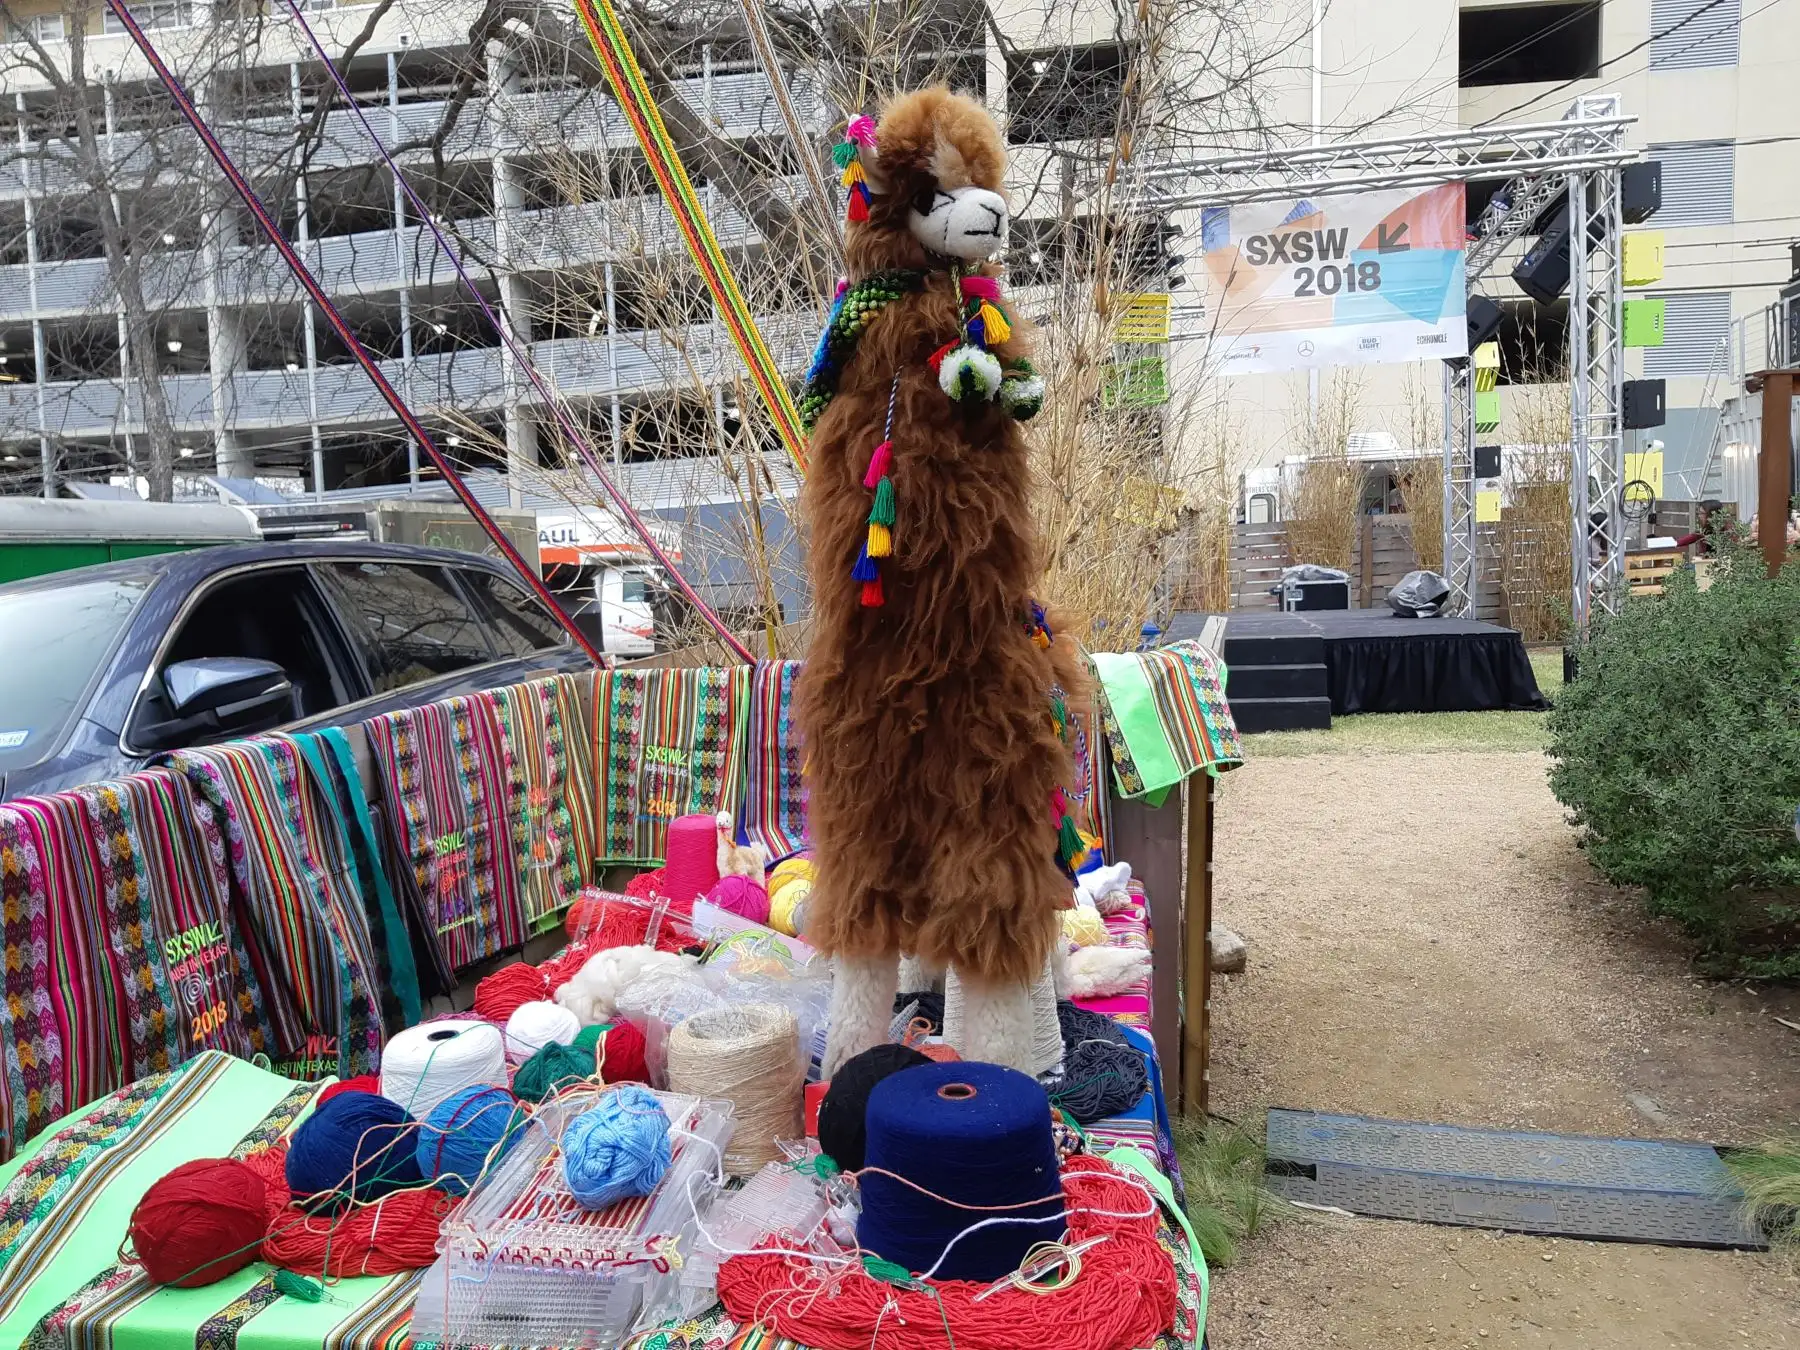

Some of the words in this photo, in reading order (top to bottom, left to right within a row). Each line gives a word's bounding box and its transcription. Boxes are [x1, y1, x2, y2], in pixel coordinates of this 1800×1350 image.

[1246, 228, 1348, 266] SXSW
[1294, 260, 1382, 298] 2018
[647, 799, 677, 816] 2018
[166, 924, 206, 964] SXSW
[191, 1001, 228, 1041] 2018
